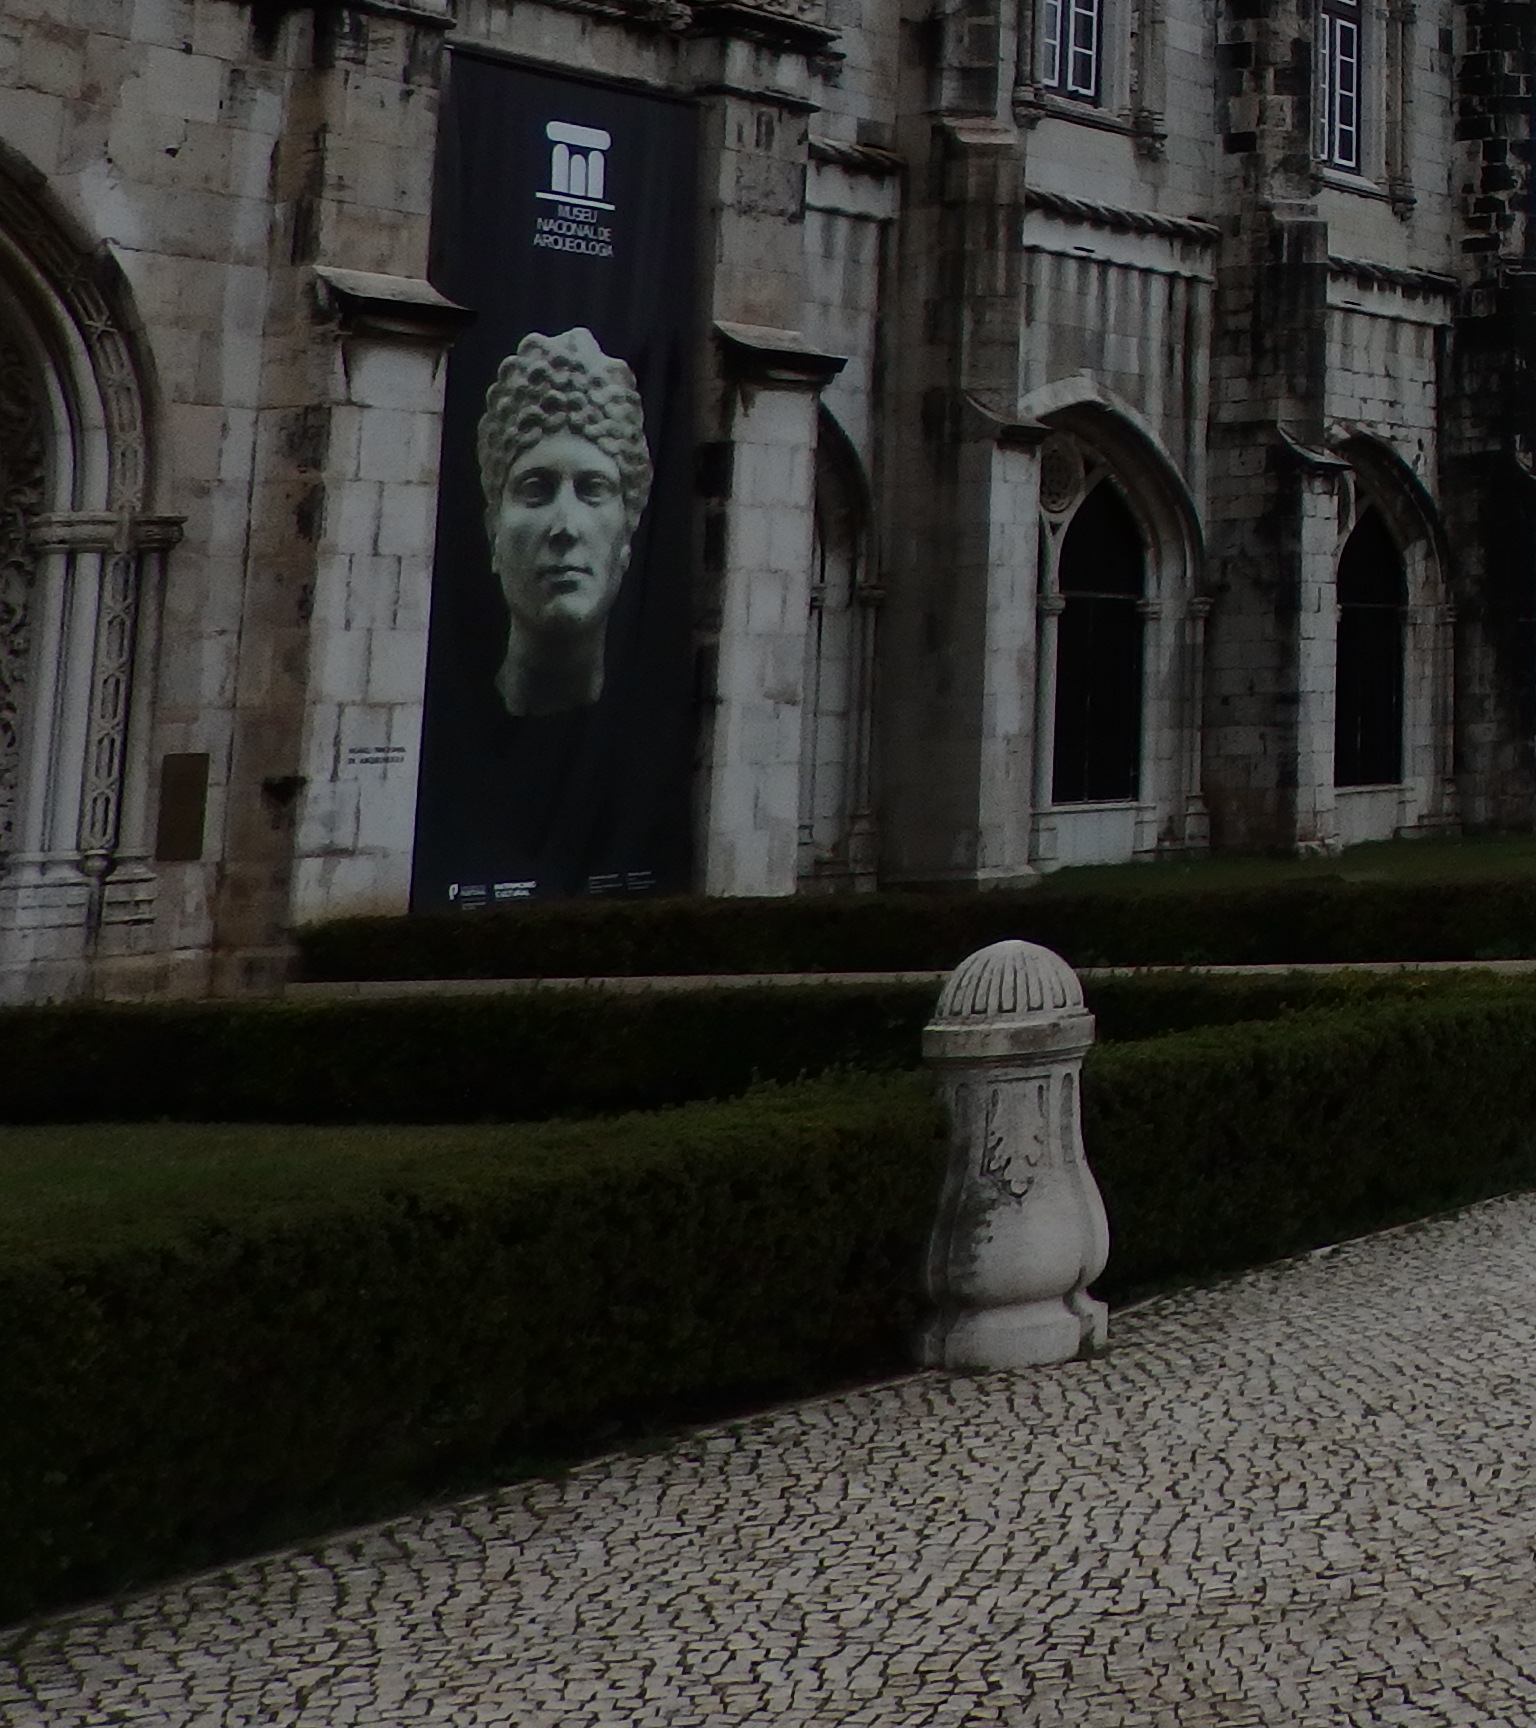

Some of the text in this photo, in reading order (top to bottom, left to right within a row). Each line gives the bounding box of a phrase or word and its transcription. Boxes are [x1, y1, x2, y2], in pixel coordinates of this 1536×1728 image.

[557, 204, 598, 223] MUSEU
[536, 217, 612, 242] NACIONAL DE
[533, 233, 614, 257] ARQUEOLOGIA
